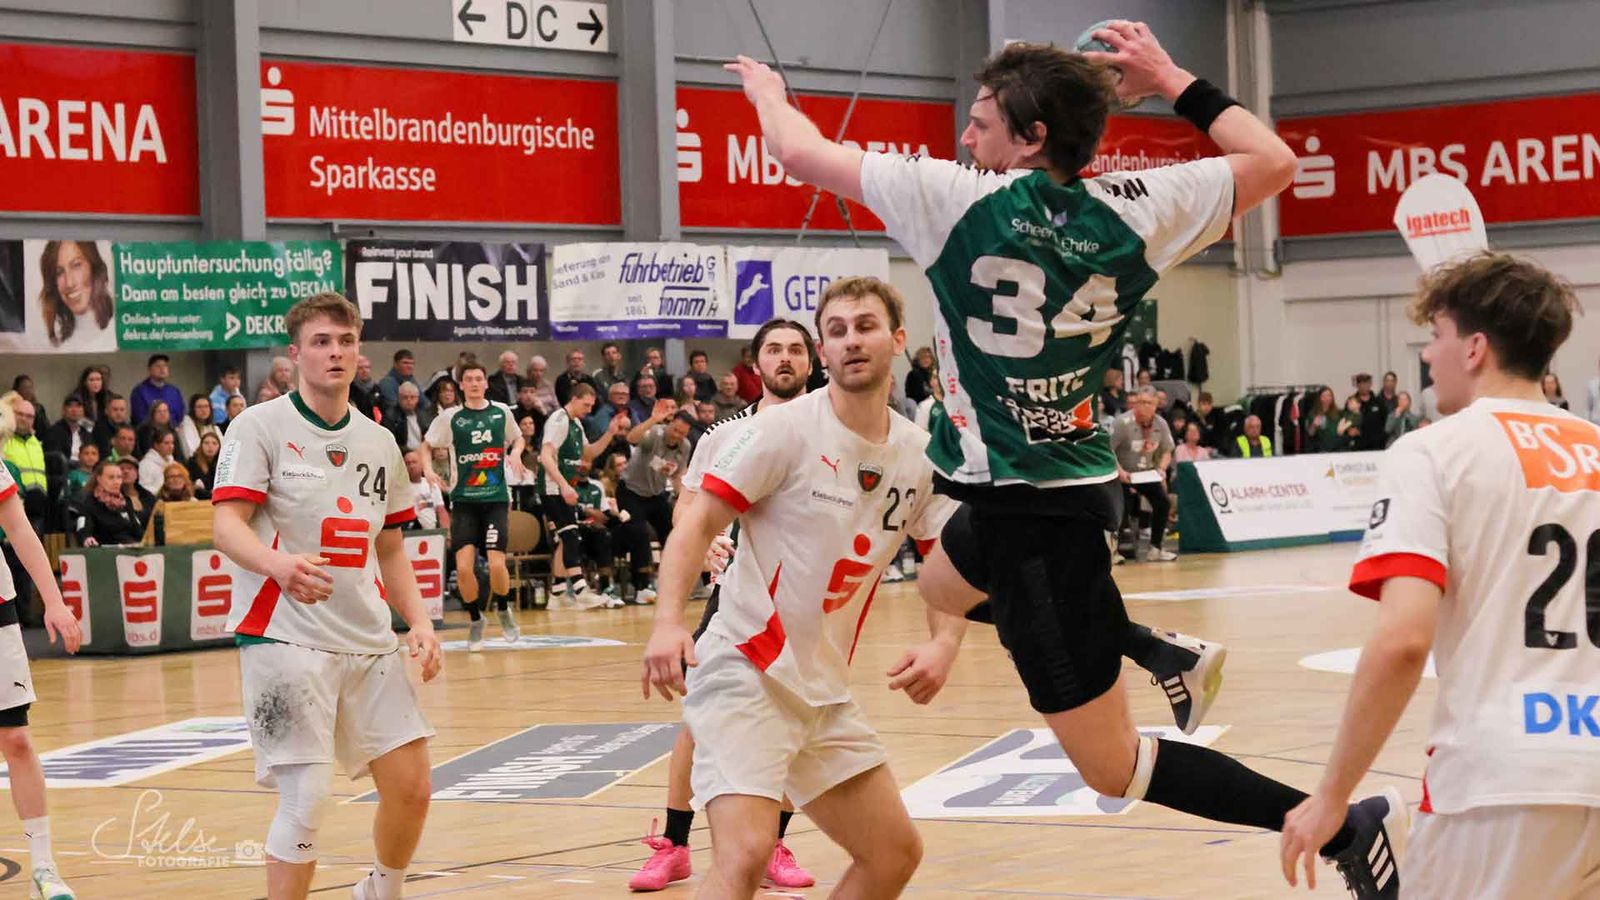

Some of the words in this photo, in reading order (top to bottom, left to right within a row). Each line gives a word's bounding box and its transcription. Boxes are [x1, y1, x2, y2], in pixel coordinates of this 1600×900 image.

[506, 2, 528, 40] D
[536, 5, 559, 42] C
[309, 106, 595, 155] Mittelbrandenburgische
[309, 155, 436, 196] Sparkasse
[120, 250, 285, 279] Hauptuntersuchung
[285, 248, 333, 278] fällig?
[122, 284, 157, 301] Dann
[160, 289, 179, 300] am
[183, 281, 225, 300] besten
[229, 281, 267, 305] gleich
[271, 286, 288, 299] zu
[355, 262, 540, 322] FINISH
[966, 254, 1124, 359] 34
[245, 315, 288, 335] DEKR
[471, 429, 493, 444] 24
[458, 451, 502, 464] ORAFOL
[356, 463, 388, 502] 24
